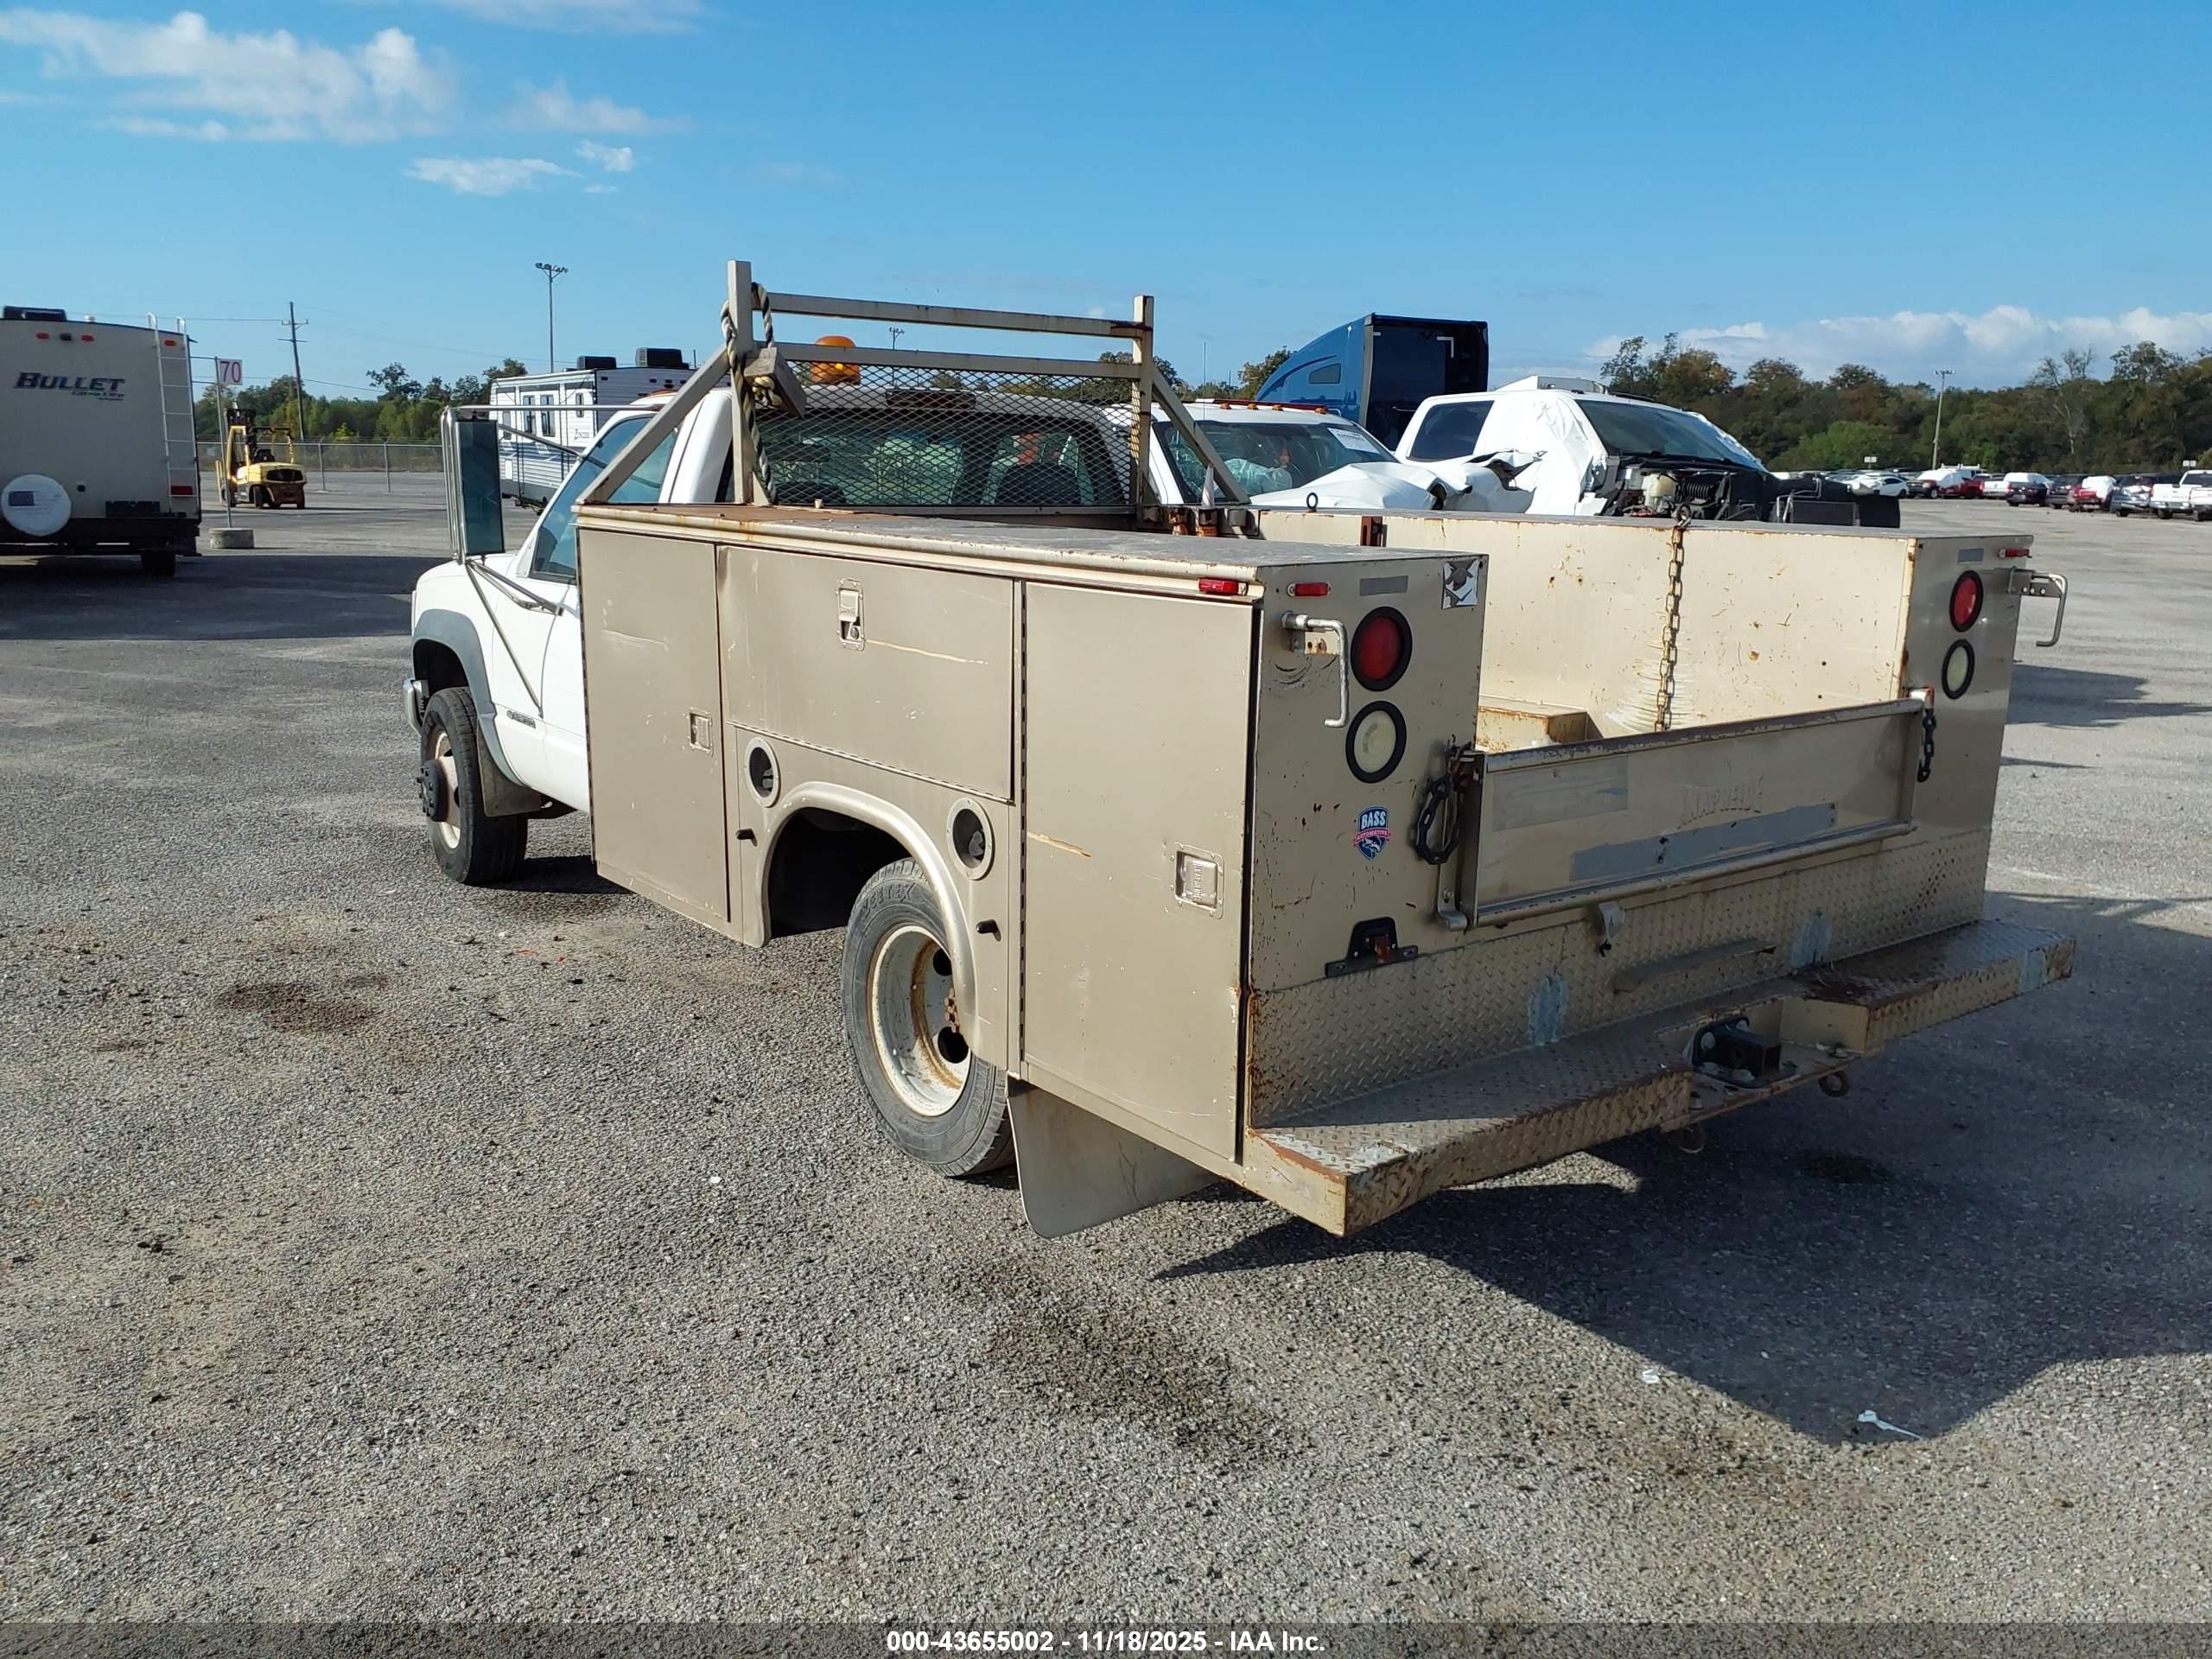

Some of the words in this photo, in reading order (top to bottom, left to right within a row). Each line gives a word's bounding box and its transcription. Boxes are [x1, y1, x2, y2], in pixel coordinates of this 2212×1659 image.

[14, 372, 125, 390] BULLET
[220, 360, 241, 383] 70
[1361, 810, 1386, 830] BASS
